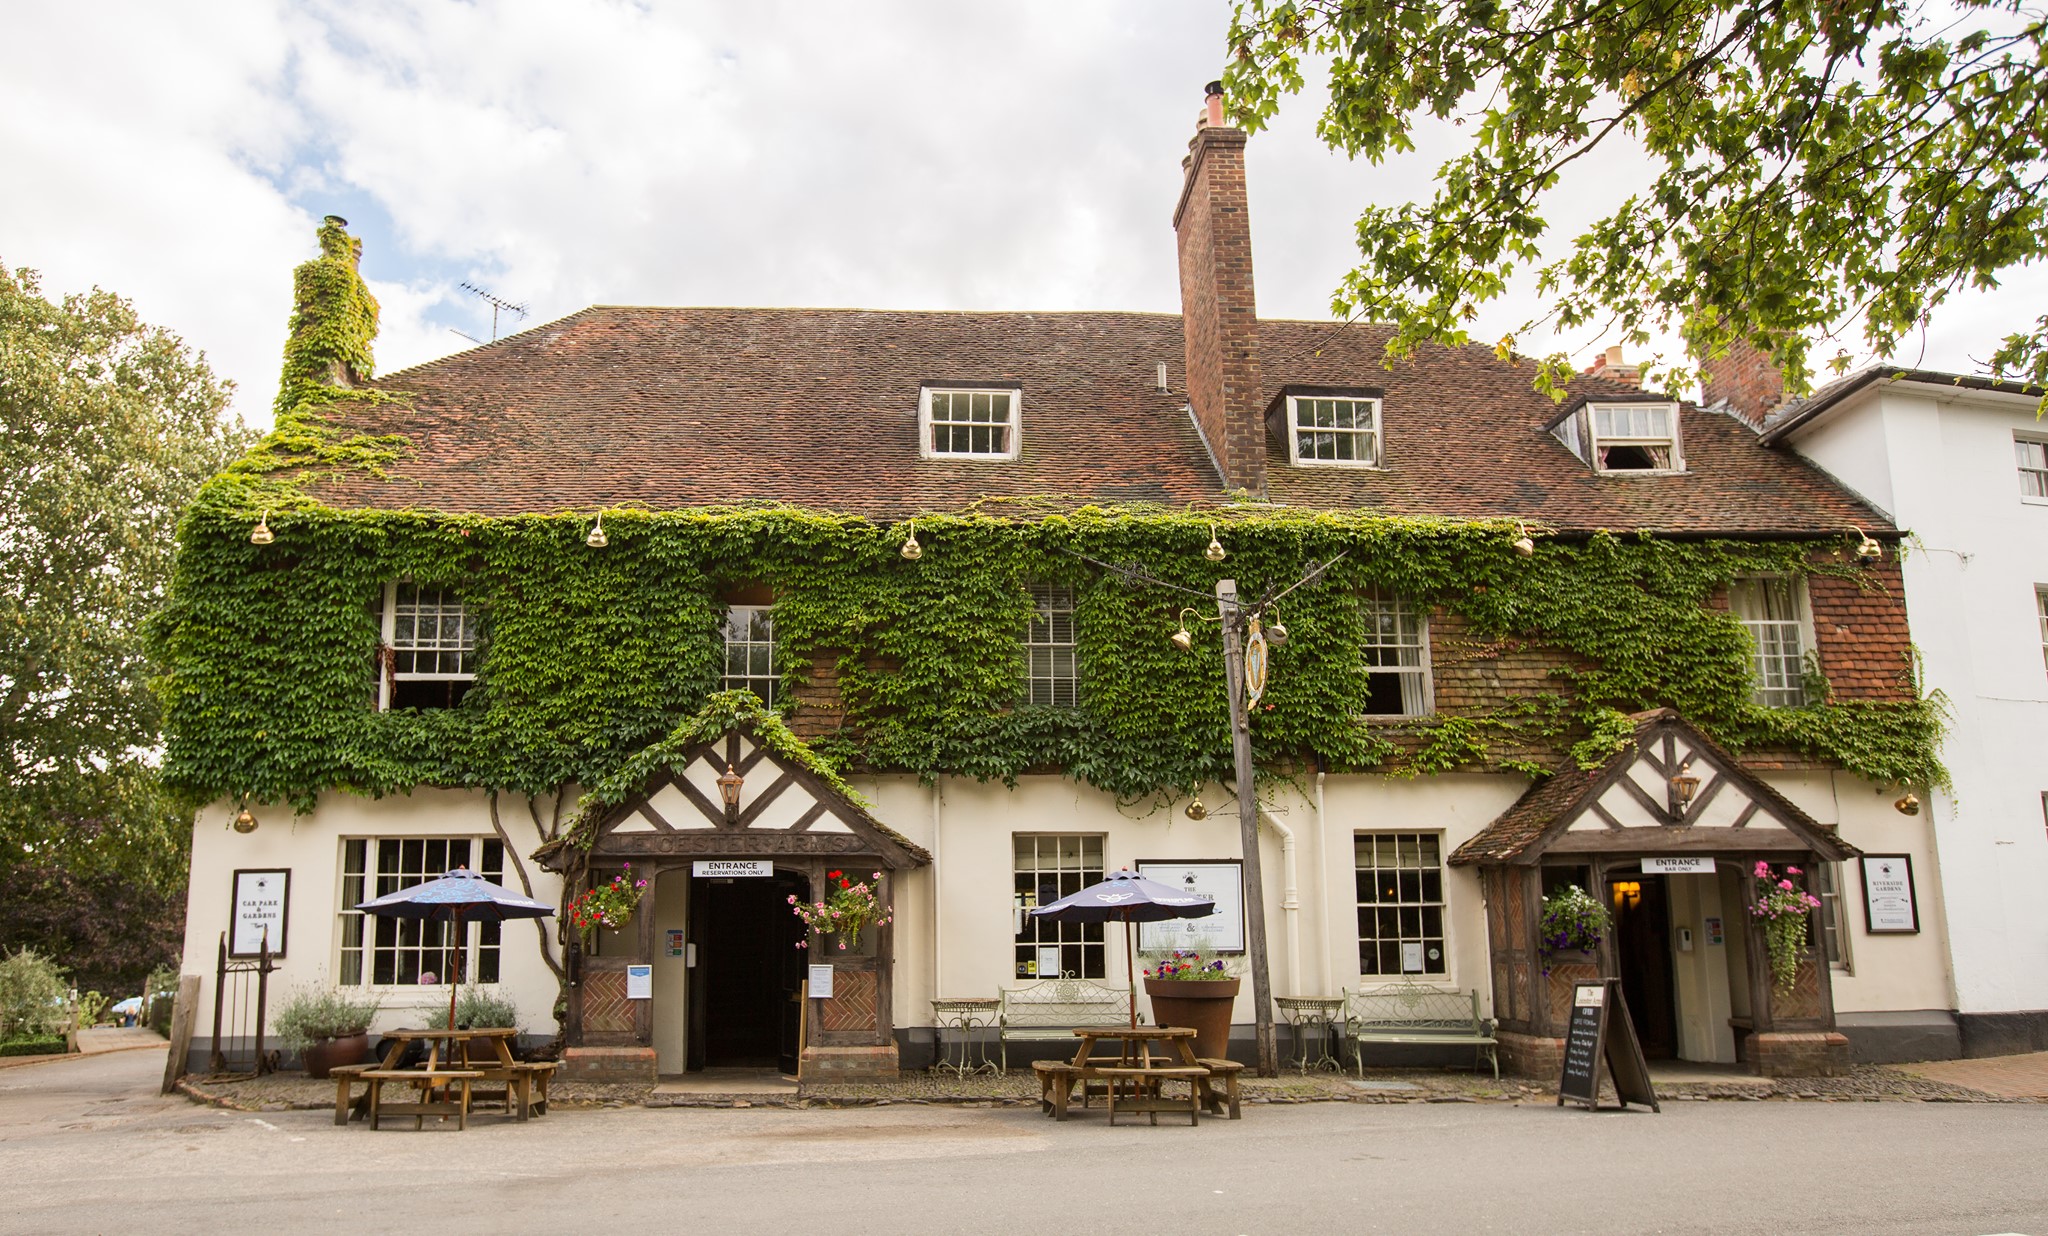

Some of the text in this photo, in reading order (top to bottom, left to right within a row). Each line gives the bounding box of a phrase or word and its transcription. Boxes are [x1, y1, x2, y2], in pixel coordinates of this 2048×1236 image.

[615, 834, 848, 853] LEICESTER ARMS
[708, 862, 758, 870] ENTRANCE
[1655, 858, 1700, 866] ENTRANCE
[1186, 922, 1196, 933] &
